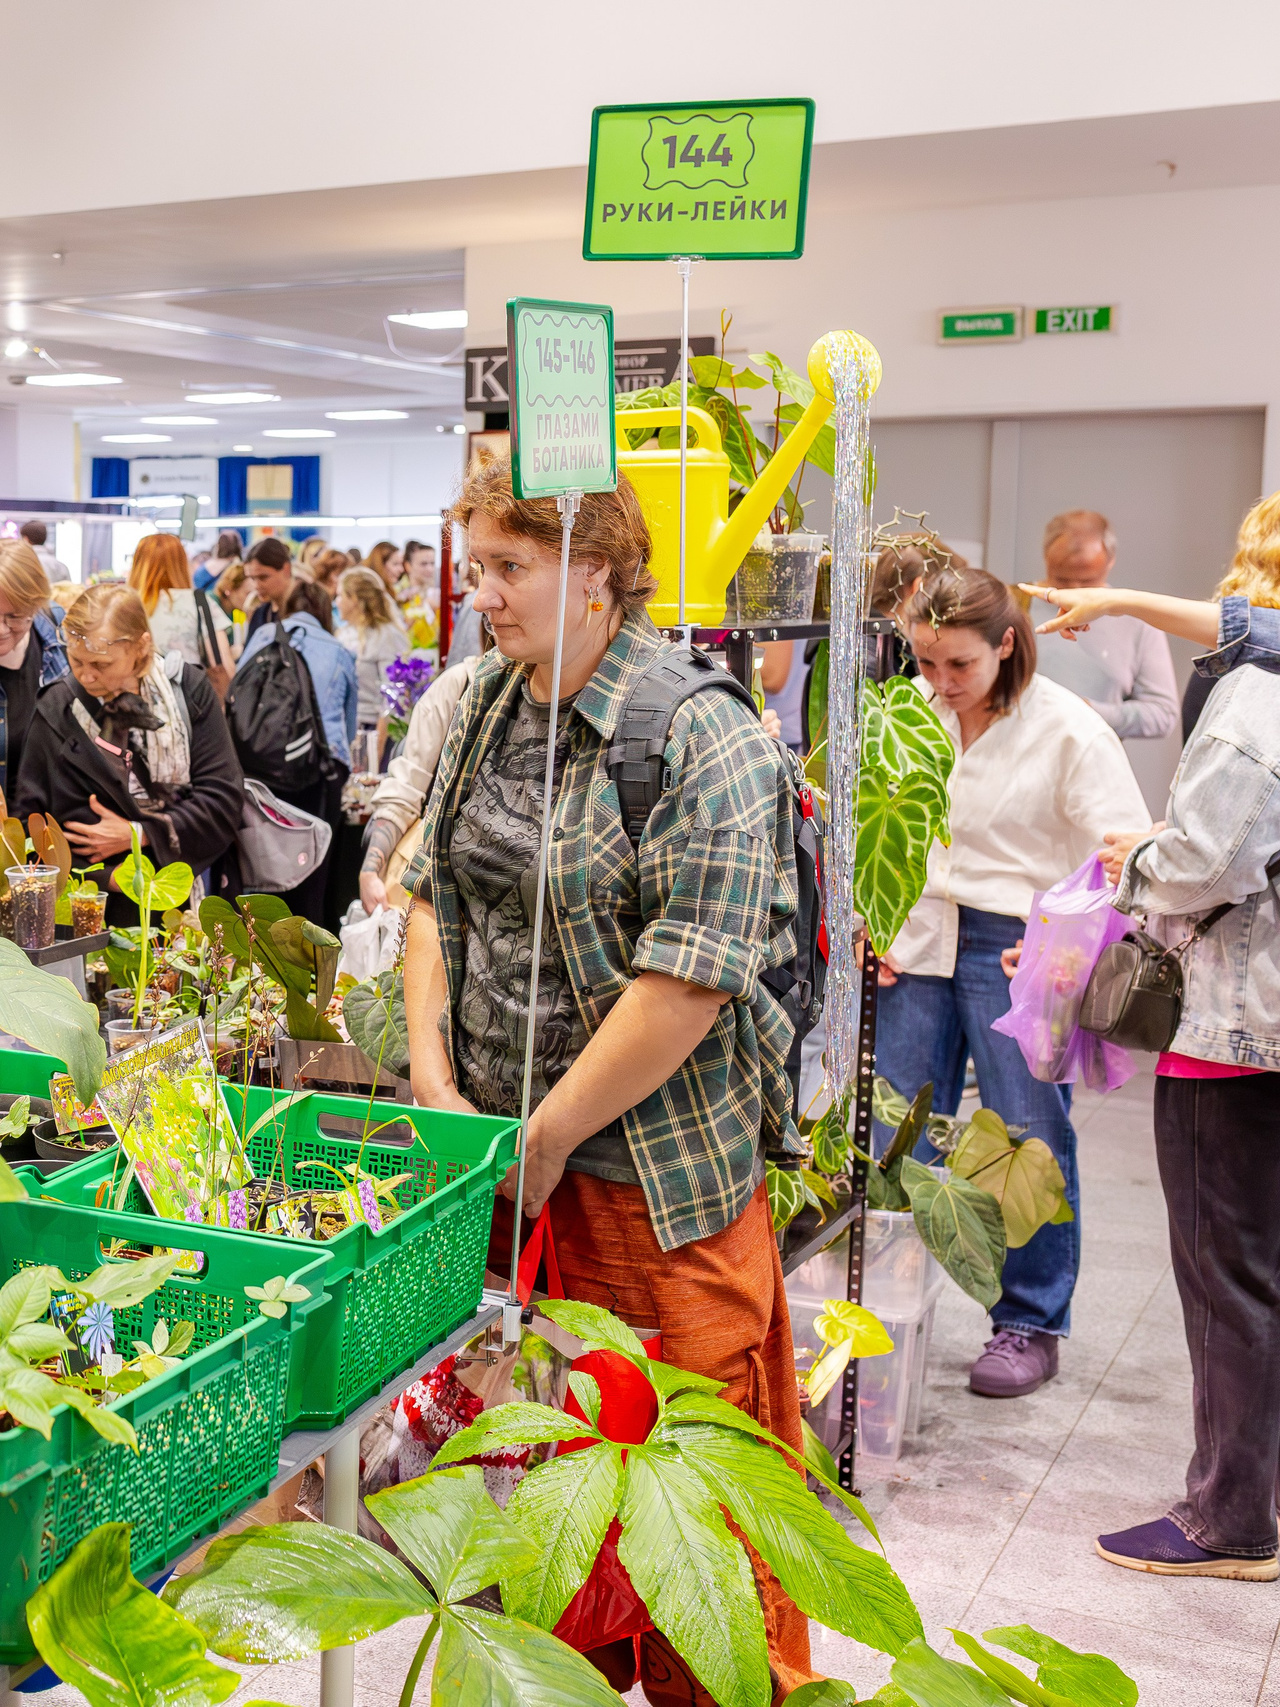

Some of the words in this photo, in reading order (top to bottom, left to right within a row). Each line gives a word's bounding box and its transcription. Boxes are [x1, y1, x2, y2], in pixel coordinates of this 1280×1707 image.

[662, 133, 733, 169] 144
[602, 195, 787, 223] РУКИ-ЛЕЙКИ
[1046, 309, 1098, 332] EXIT
[535, 337, 596, 374] 145-146
[536, 412, 600, 440] ГЛАЗАМИ
[532, 443, 605, 474] БОТАНИКА
